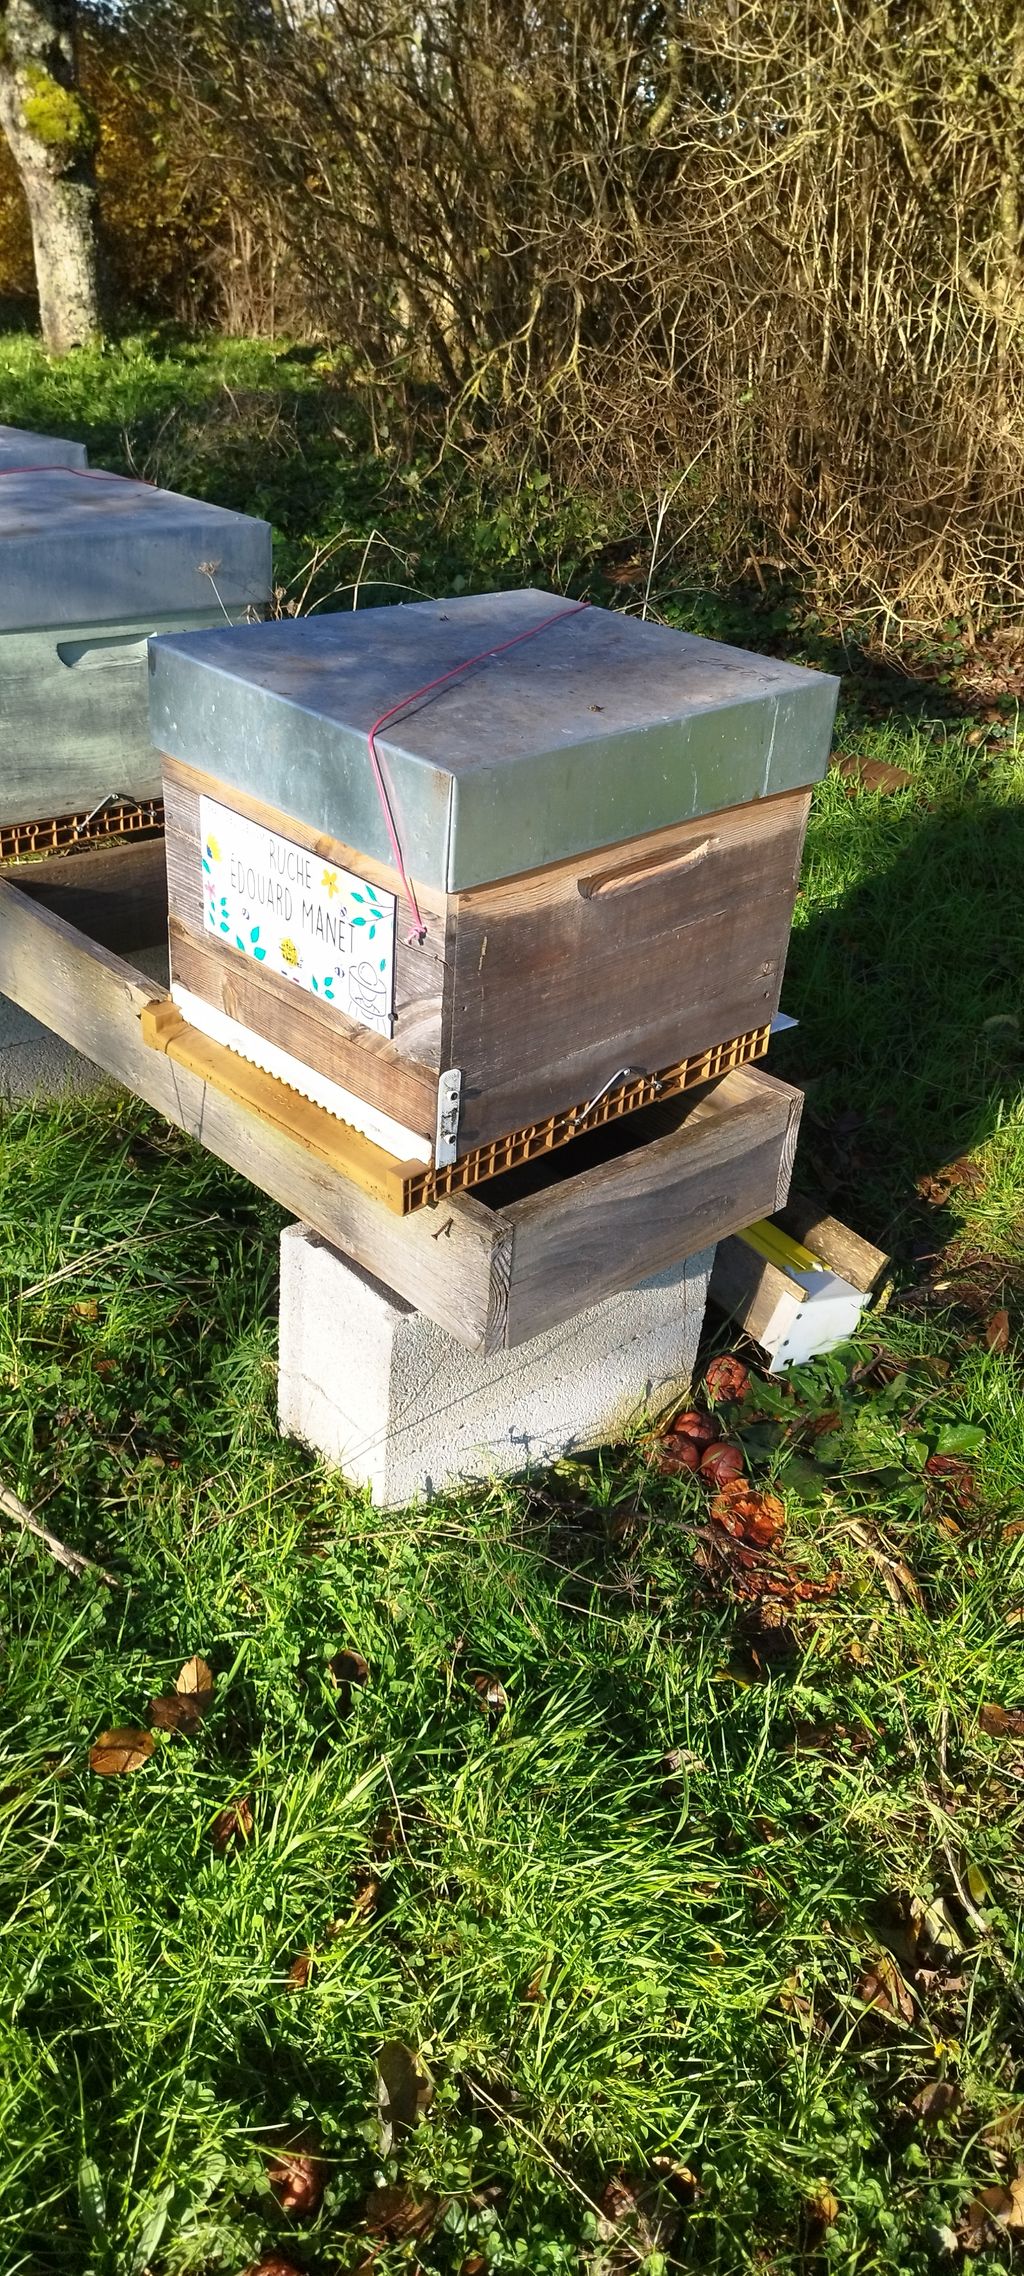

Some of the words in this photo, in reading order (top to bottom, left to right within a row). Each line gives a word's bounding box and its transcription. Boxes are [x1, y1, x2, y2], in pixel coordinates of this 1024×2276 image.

[269, 838, 312, 889] RUCHE
[230, 852, 293, 921] ÉDOUARD
[302, 899, 356, 954] MANET
